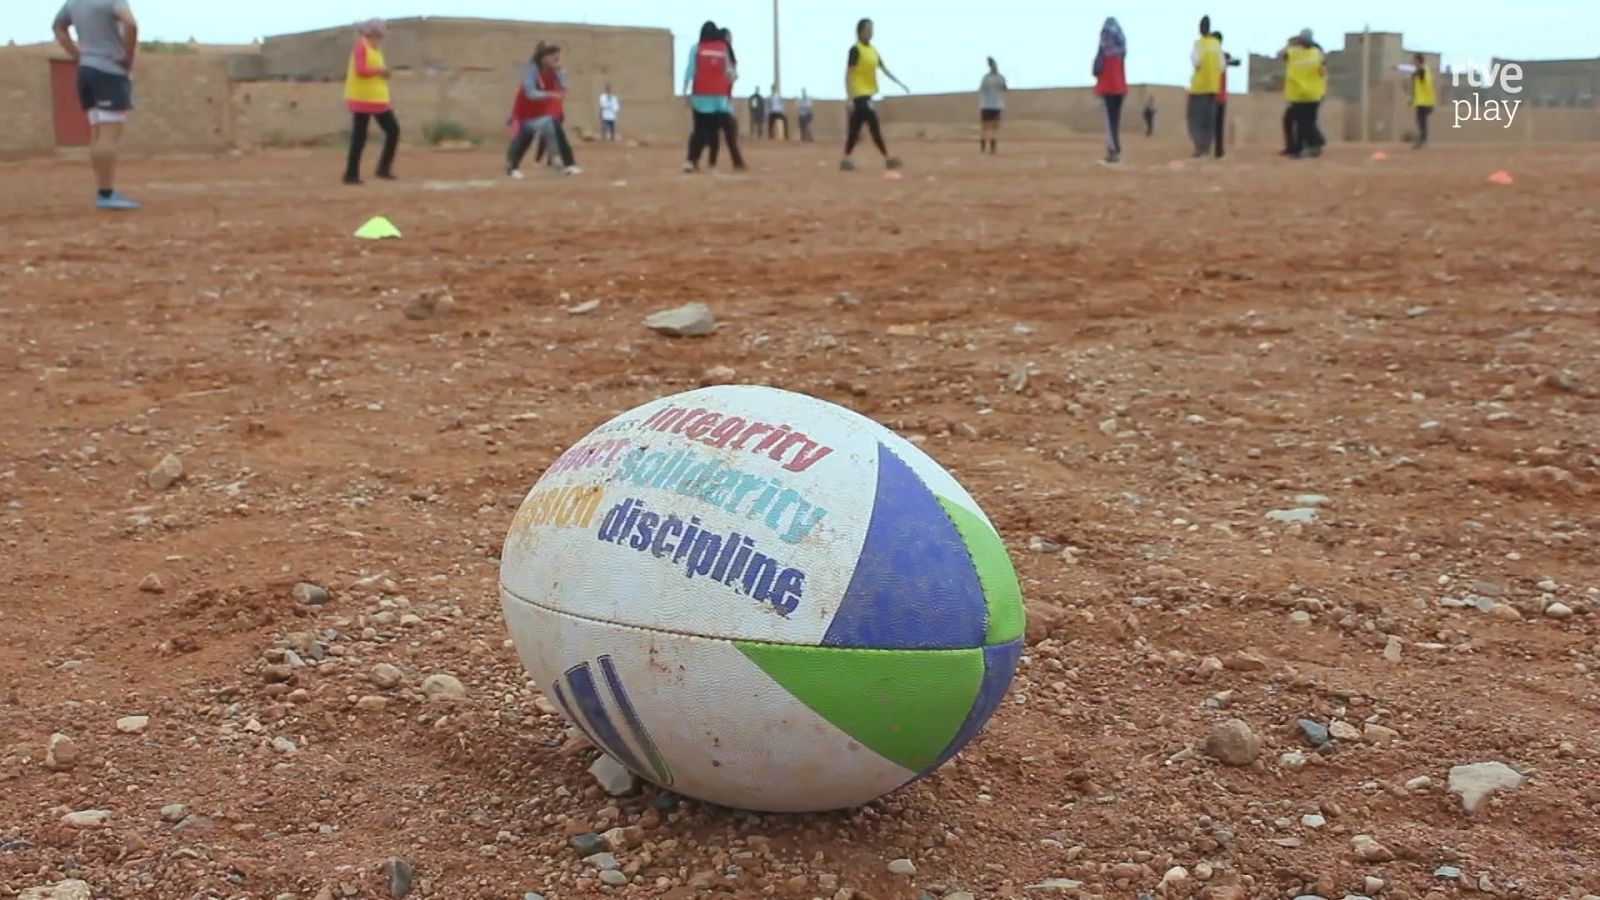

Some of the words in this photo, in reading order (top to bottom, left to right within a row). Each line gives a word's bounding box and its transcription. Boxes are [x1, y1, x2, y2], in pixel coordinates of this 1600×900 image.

[639, 404, 835, 472] integrity
[617, 448, 827, 545] solidarity
[598, 497, 806, 617] discipline
